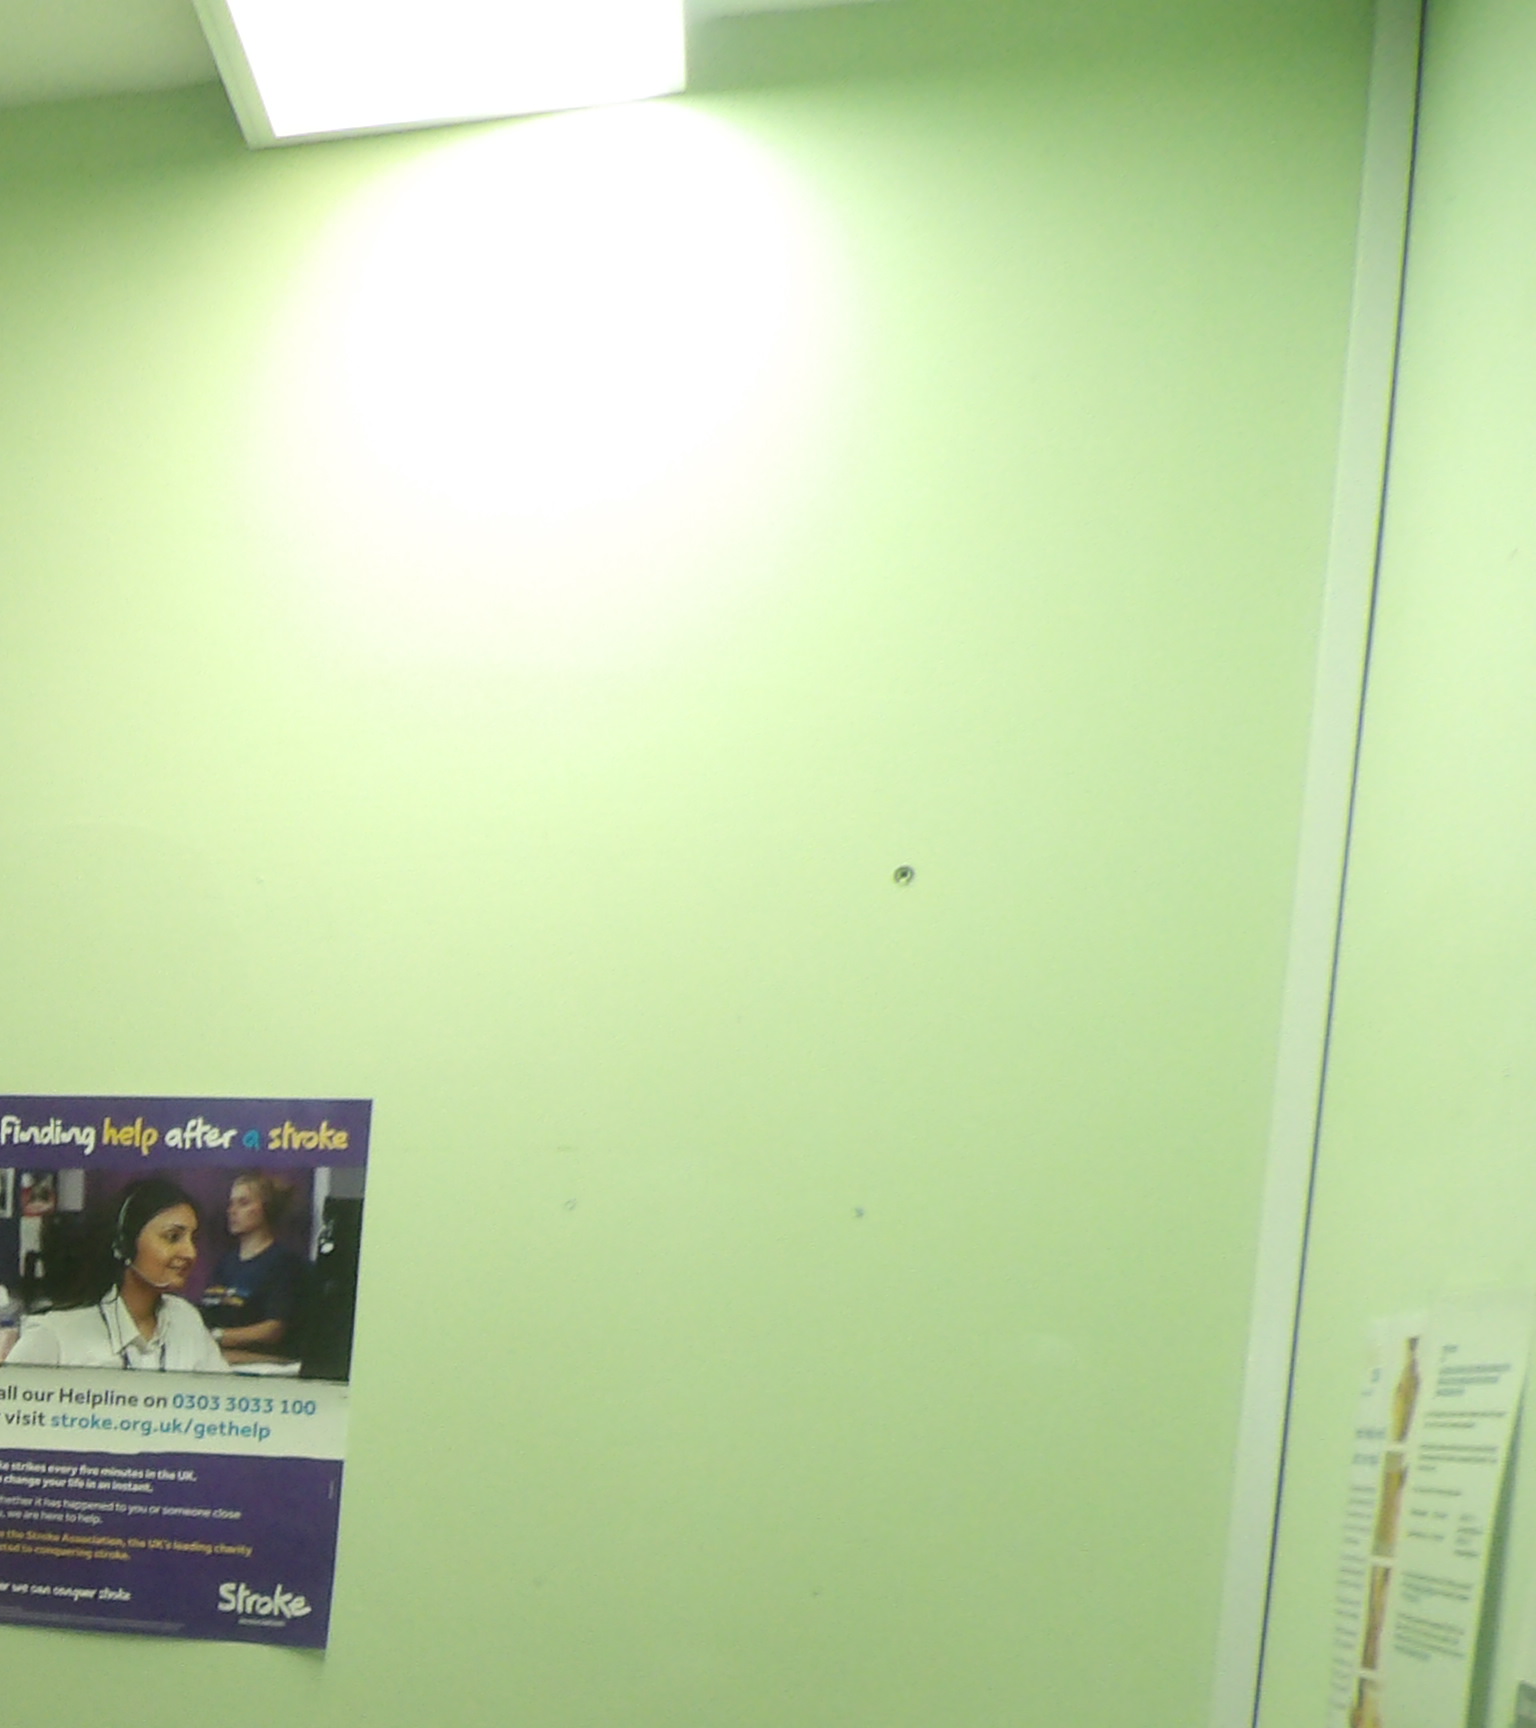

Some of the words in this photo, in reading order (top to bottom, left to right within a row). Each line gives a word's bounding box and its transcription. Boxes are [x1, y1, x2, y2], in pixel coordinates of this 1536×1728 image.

[0, 1114, 96, 1156] Finding
[102, 1117, 158, 1156] help
[164, 1117, 237, 1150] after
[242, 1128, 260, 1148] a
[268, 1120, 349, 1151] stroke
[22, 1388, 53, 1402] our
[60, 1387, 138, 1409] Helpline
[143, 1394, 167, 1408] on
[172, 1394, 220, 1411] 0303
[225, 1396, 274, 1413] 3033
[281, 1399, 316, 1416] 100
[5, 1408, 46, 1426] visit
[50, 1411, 272, 1441] stroke.org.uk/gethelp
[11, 1461, 46, 1473] strikes
[48, 1464, 78, 1477] every
[79, 1464, 99, 1475] five
[100, 1466, 144, 1479] minutes
[145, 1468, 156, 1479] in
[157, 1469, 176, 1481] the
[177, 1469, 197, 1482] UK.
[3, 1474, 42, 1488] change
[42, 1478, 66, 1488] your
[67, 1477, 85, 1488] life
[86, 1478, 96, 1488] in
[97, 1480, 111, 1489] an
[112, 1481, 154, 1493] instant.
[7, 1510, 22, 1519] we
[23, 1510, 39, 1519] are
[40, 1511, 64, 1522] here
[65, 1512, 77, 1522] to
[34, 1497, 42, 1506] it
[43, 1498, 62, 1508] has
[63, 1499, 114, 1511] happened
[115, 1502, 127, 1512] to
[128, 1504, 147, 1515] you
[149, 1506, 160, 1514] or
[162, 1506, 211, 1518] someone
[212, 1508, 242, 1520] close
[30, 1584, 51, 1595] can
[52, 1585, 98, 1602] conquer
[217, 1582, 312, 1619] Stroke
